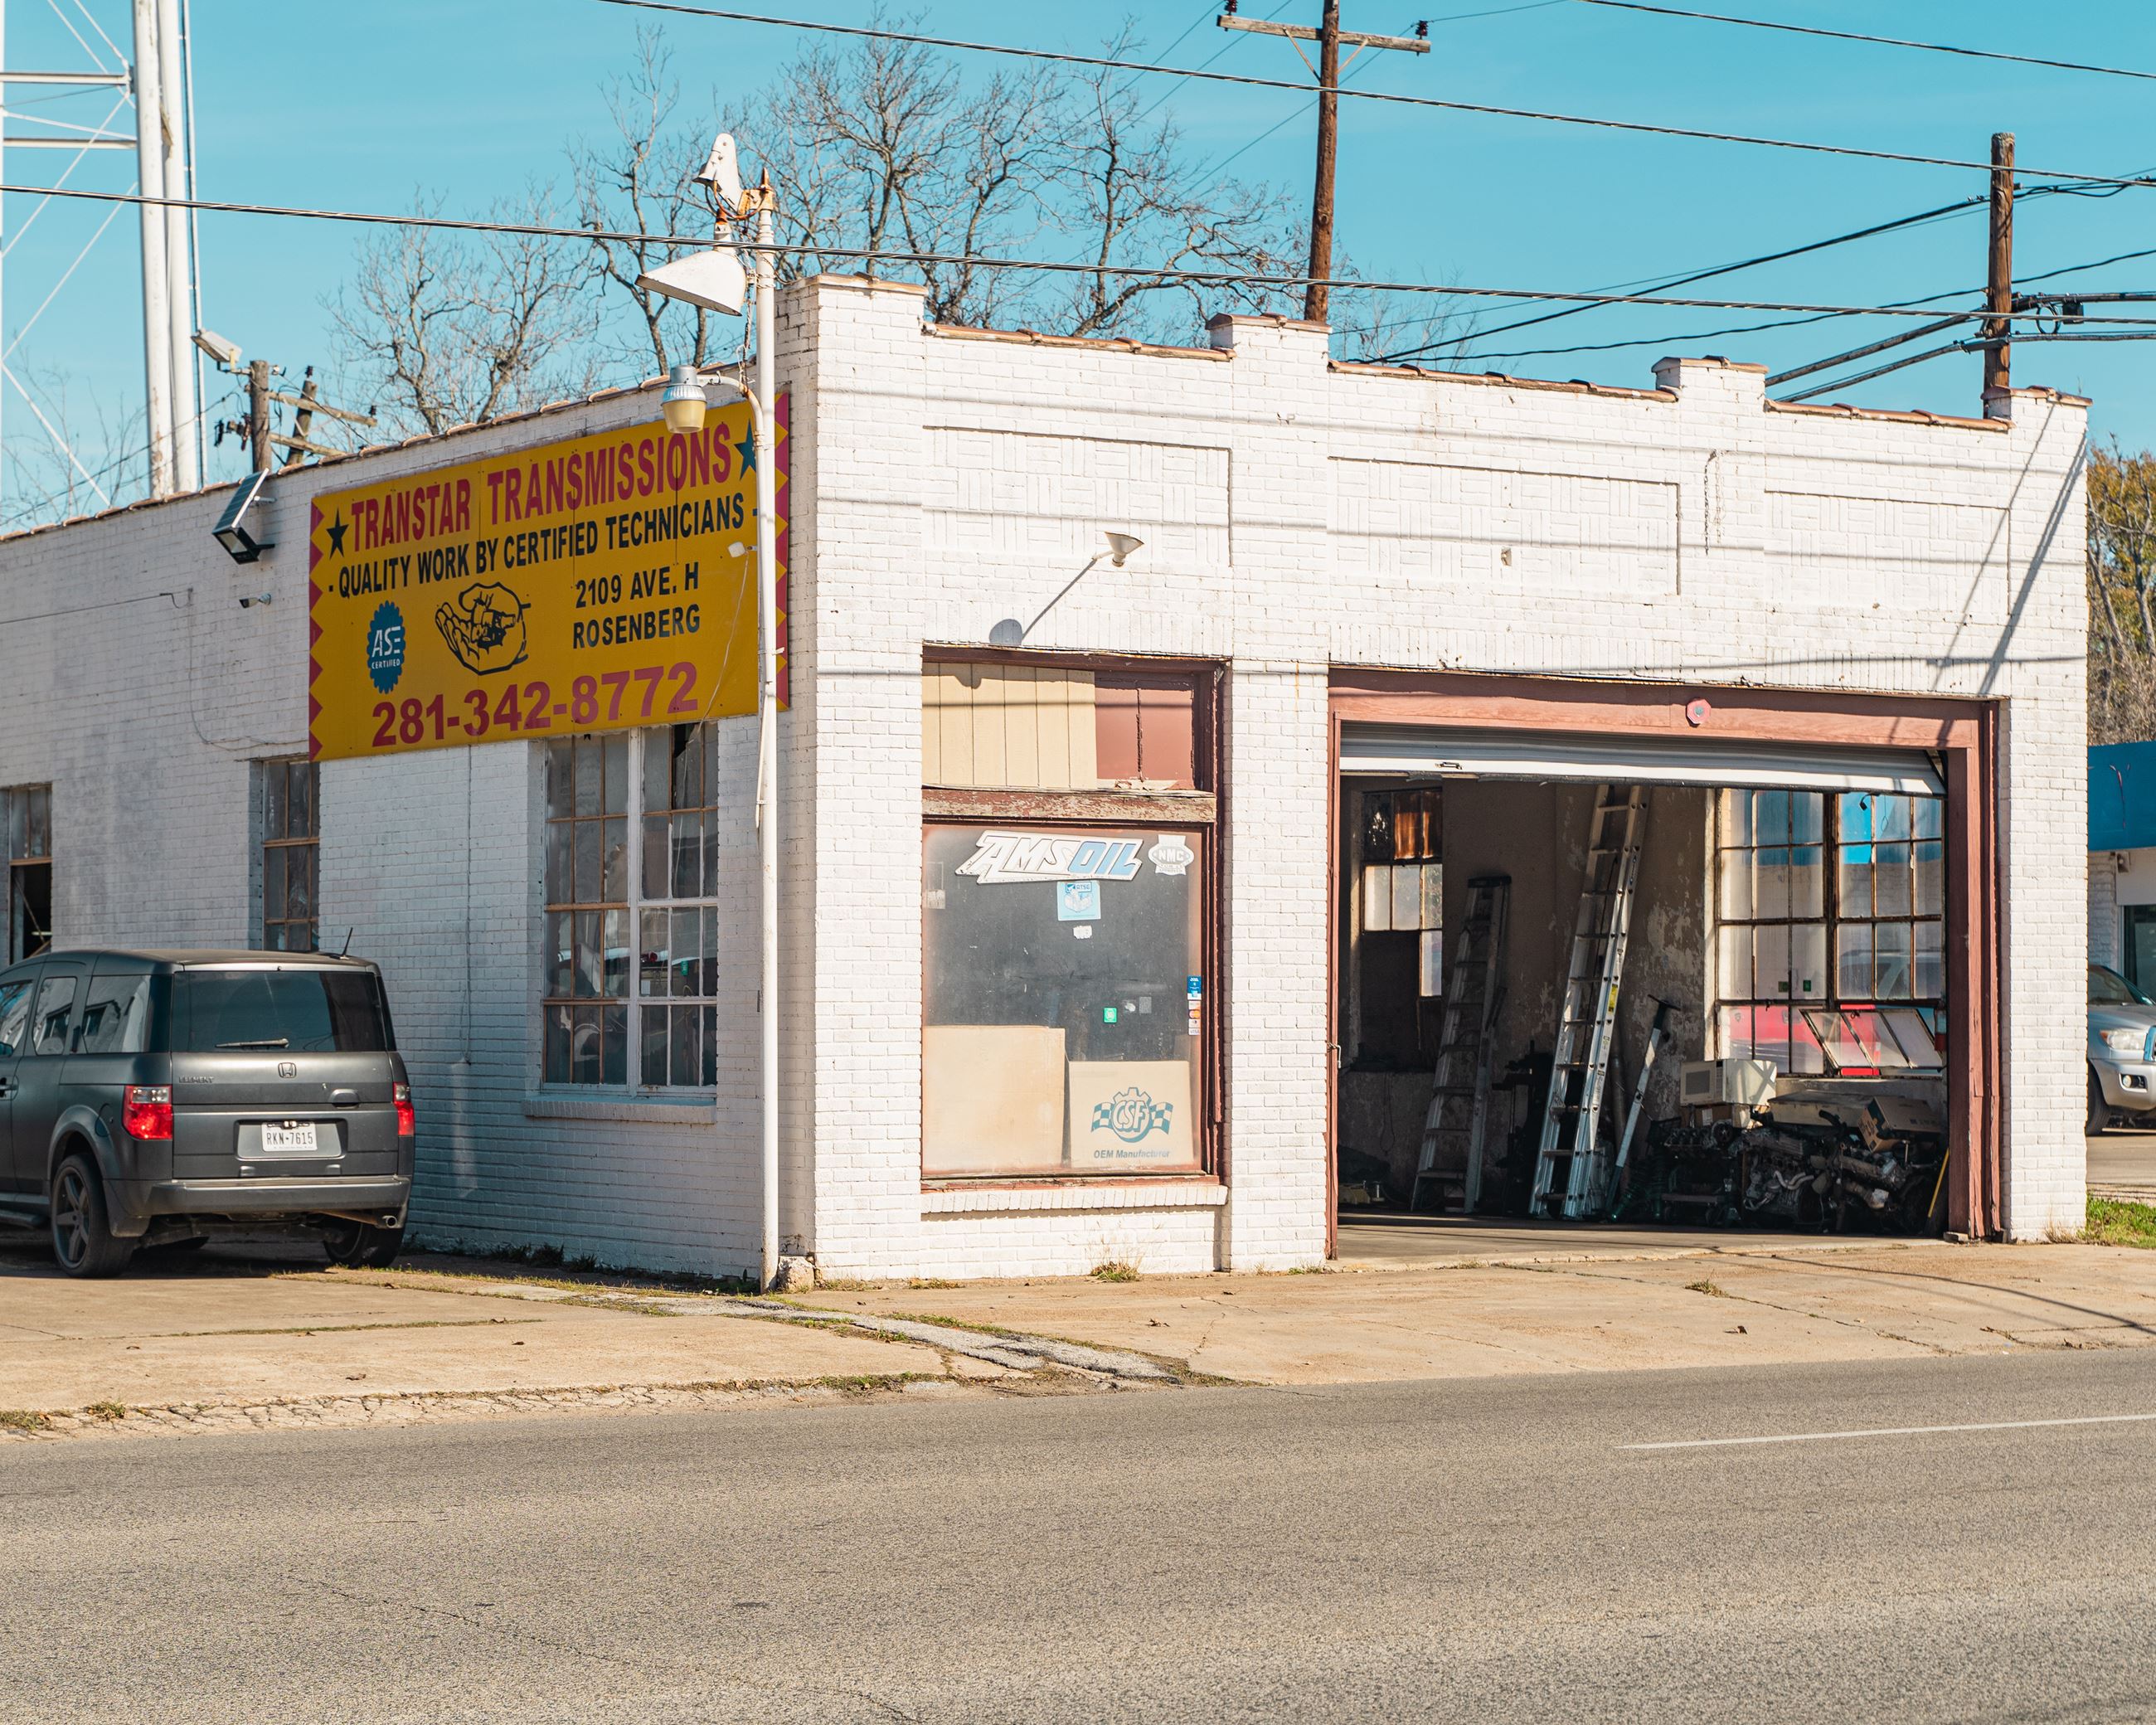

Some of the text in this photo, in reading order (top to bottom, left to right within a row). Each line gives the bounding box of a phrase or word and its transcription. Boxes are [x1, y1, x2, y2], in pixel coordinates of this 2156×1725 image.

[351, 423, 731, 552] TRANSTAR TRANSMISSIONS
[338, 492, 744, 599] QUALITY WORK BY CERTIFIED TECHNICIANS
[575, 561, 699, 609] 2109 AVE. H
[371, 626, 401, 658] ASE
[573, 604, 701, 649] ROSENBERG
[372, 662, 698, 746] 281-342-8772
[965, 834, 1138, 879] AMSOIL
[1158, 848, 1184, 862] NMC
[1112, 1100, 1147, 1133] CSF
[1094, 1149, 1170, 1159] OEM Manufacturer
